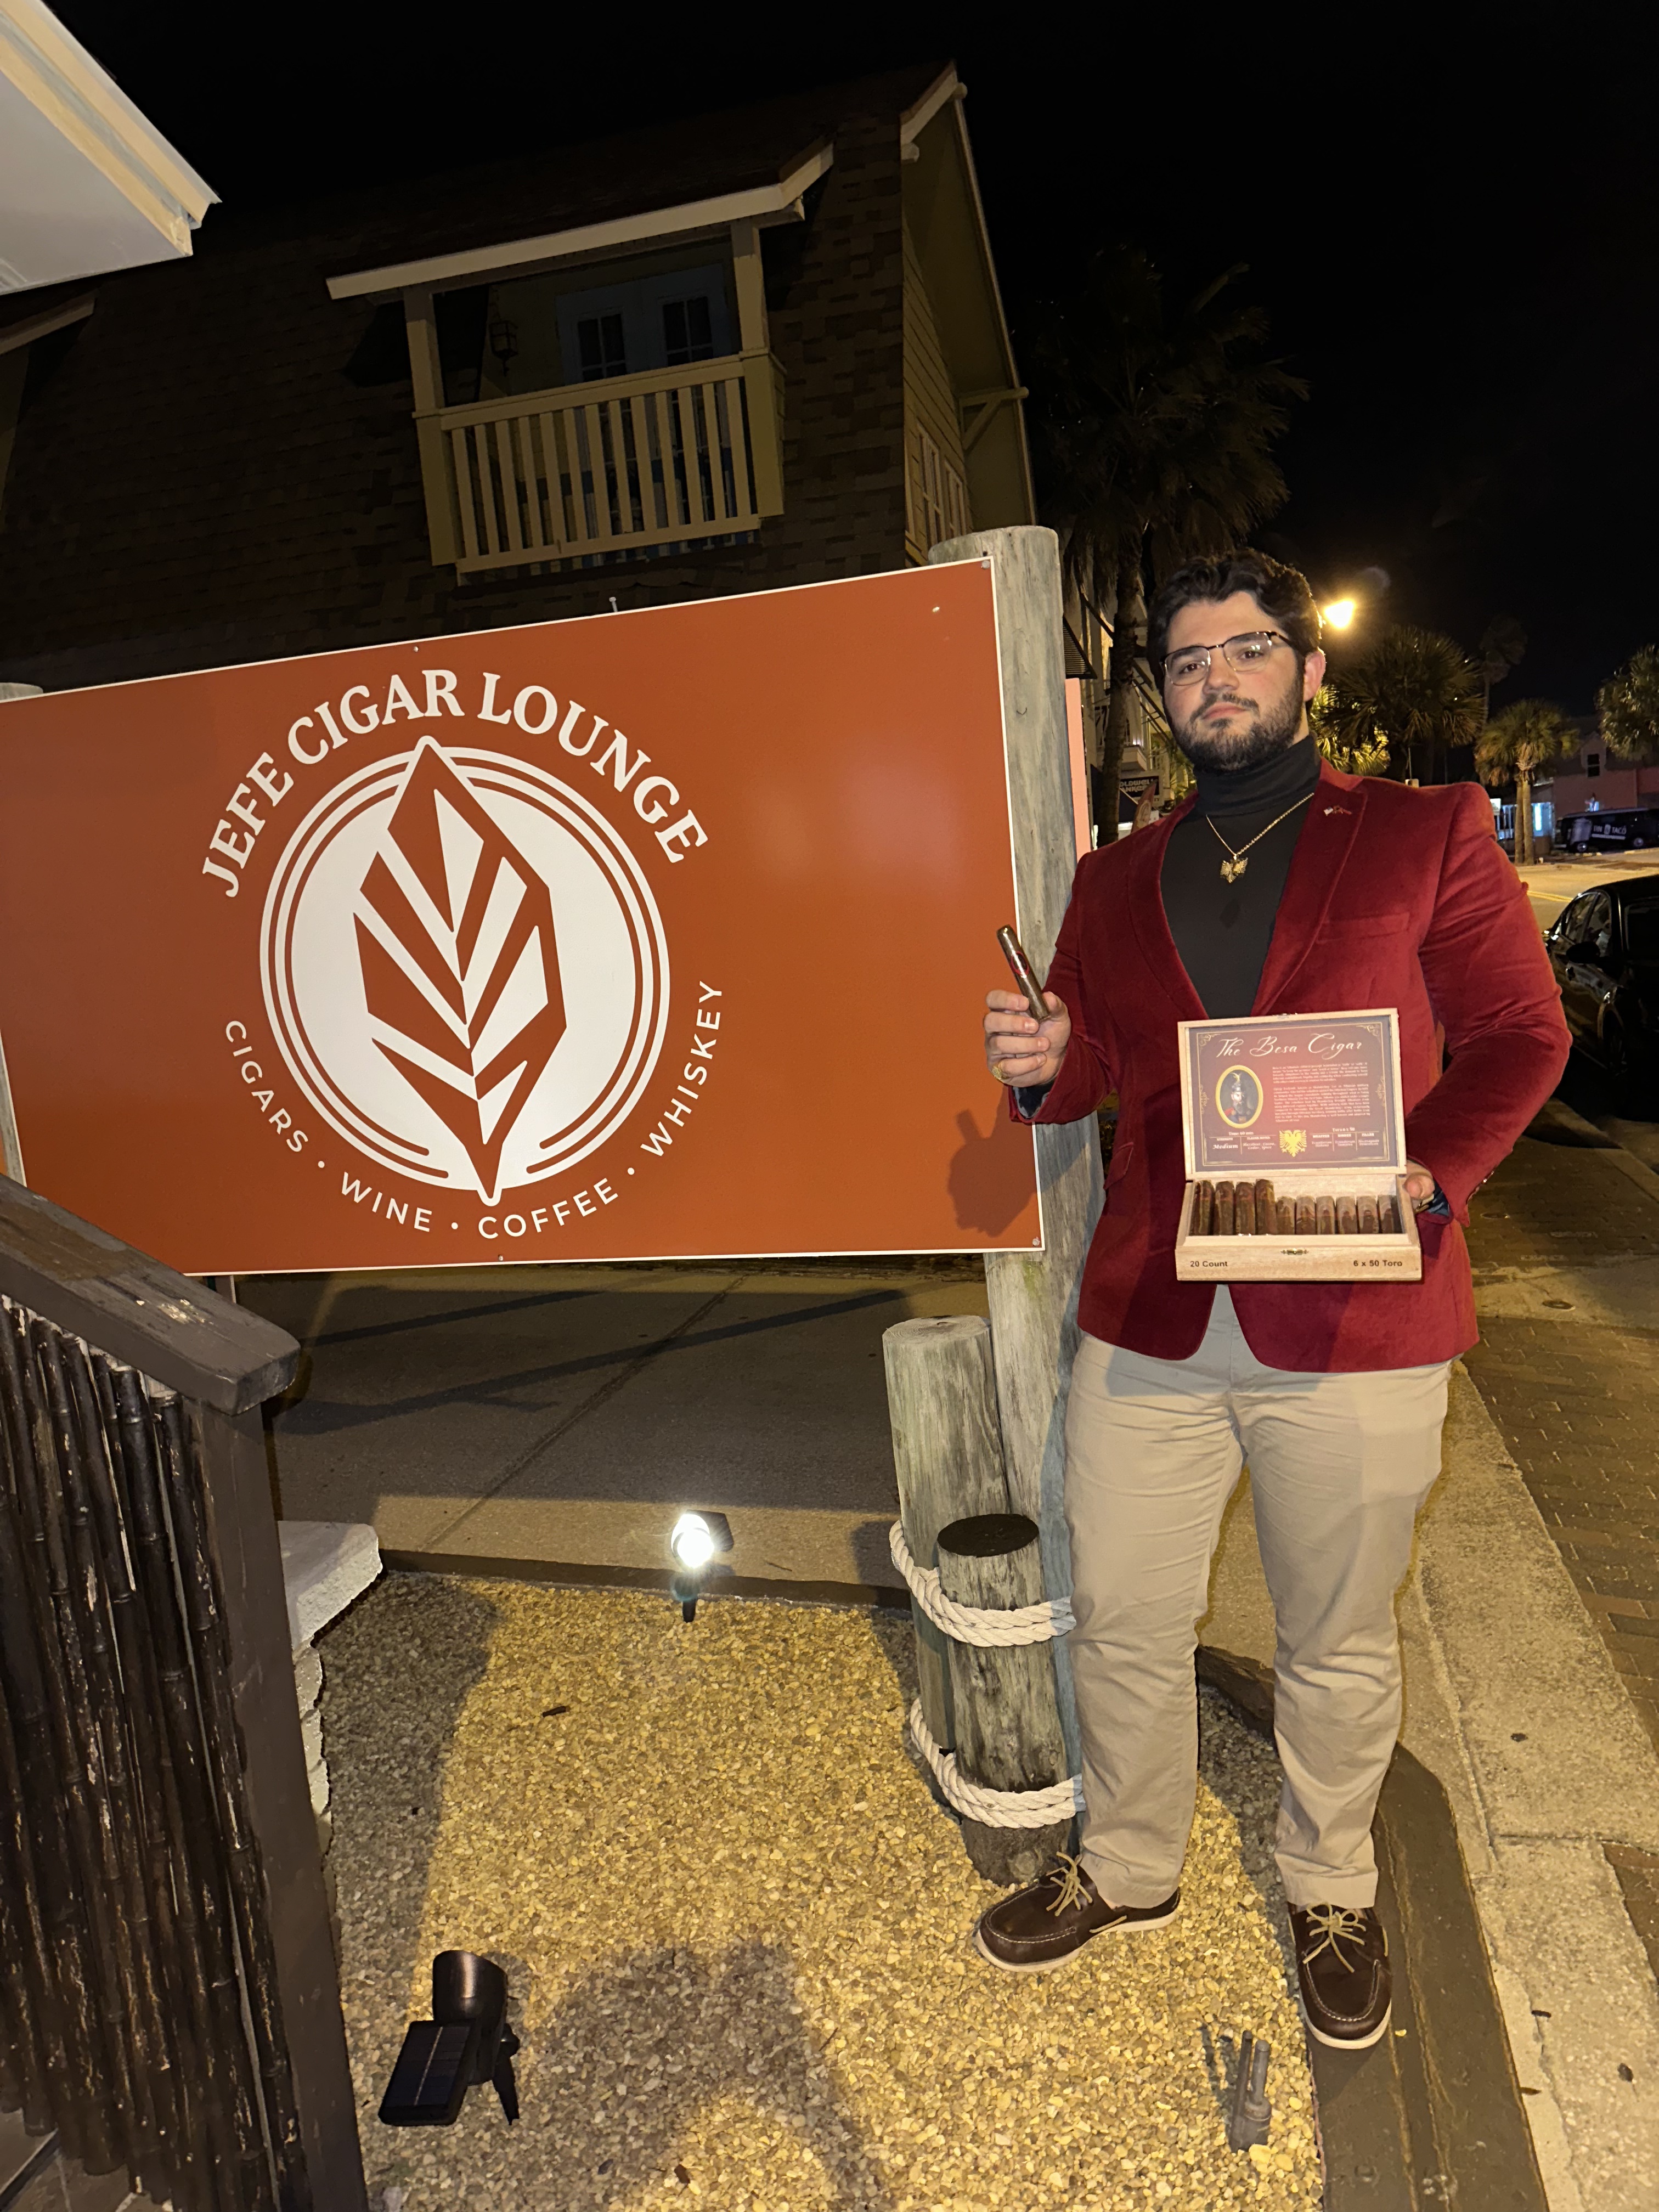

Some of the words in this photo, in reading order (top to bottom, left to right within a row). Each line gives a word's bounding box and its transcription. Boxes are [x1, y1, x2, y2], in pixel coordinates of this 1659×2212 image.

[202, 752, 294, 897] JEFE
[288, 670, 465, 764] CIGAR
[477, 673, 708, 863] LOUNGE
[226, 1021, 308, 1152] CIGARS
[342, 1172, 432, 1232] WINE
[478, 1178, 618, 1239] COFFEE
[641, 981, 721, 1156] WHISKEY
[1216, 1037, 1244, 1058] The
[1308, 1032, 1362, 1060] Cigar
